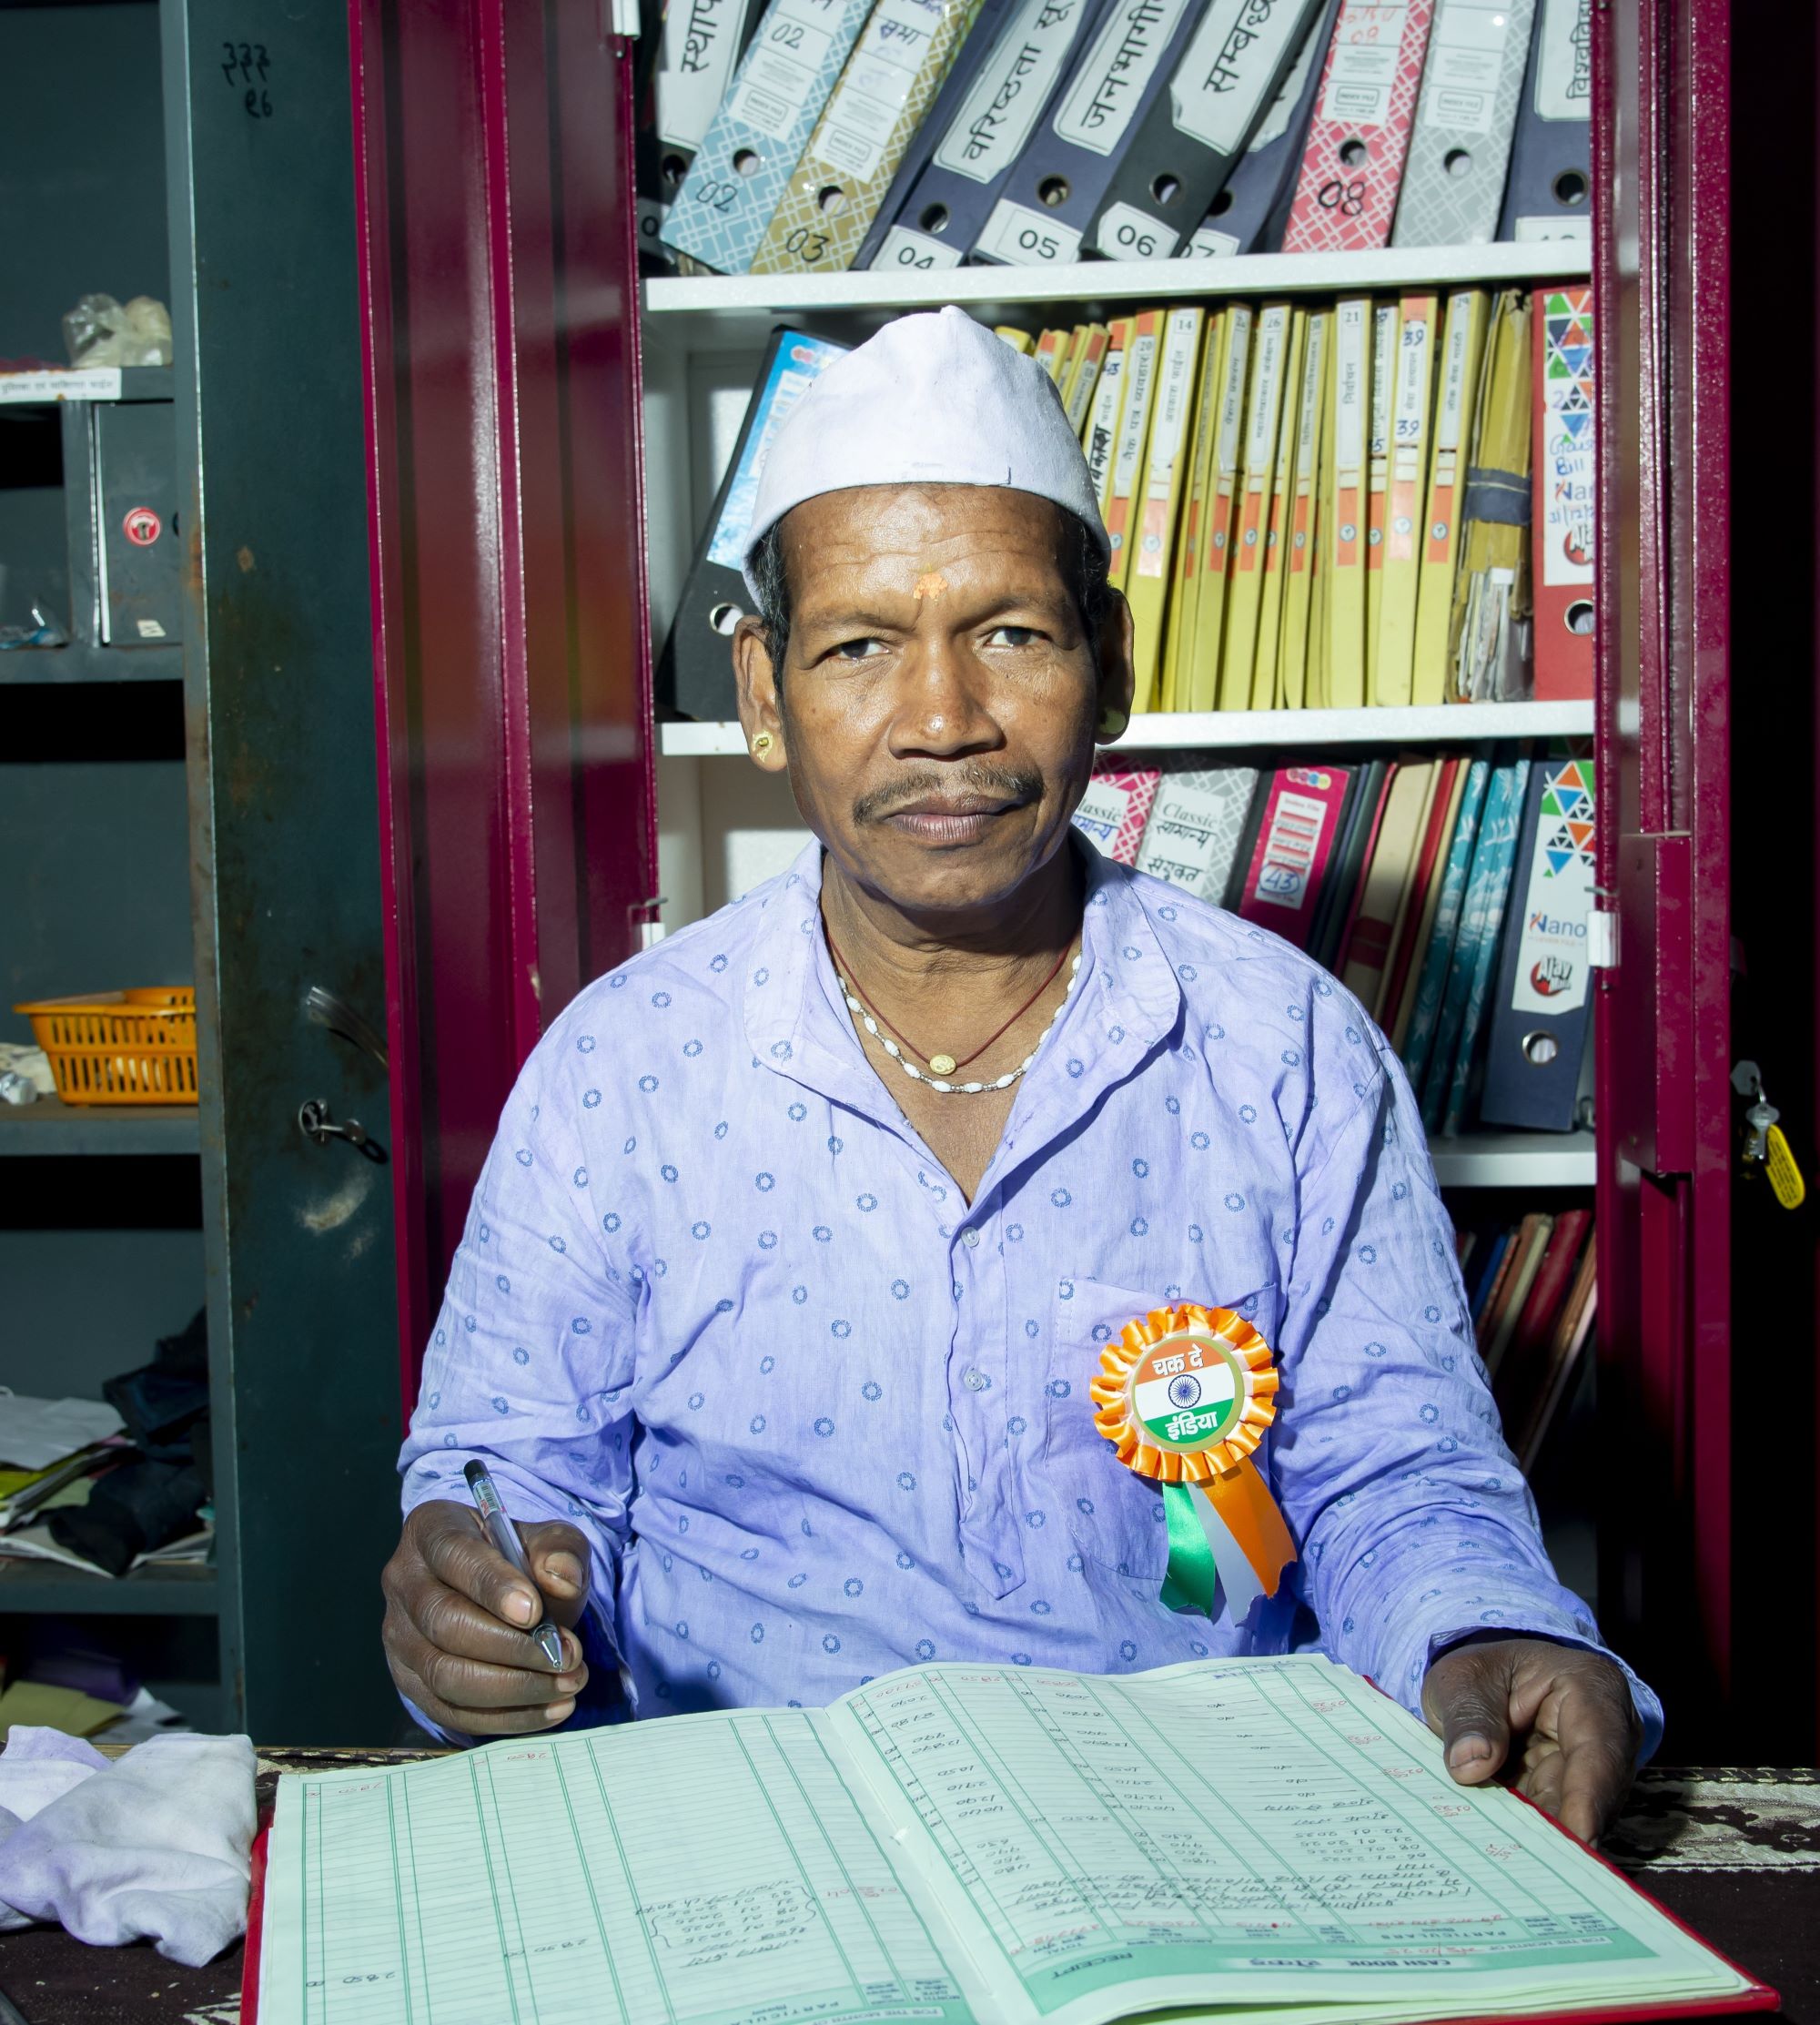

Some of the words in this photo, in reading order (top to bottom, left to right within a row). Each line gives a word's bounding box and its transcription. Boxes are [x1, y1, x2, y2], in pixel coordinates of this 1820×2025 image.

[772, 24, 805, 49] 02
[696, 182, 737, 212] 02
[1318, 181, 1366, 217] 08
[785, 228, 830, 262] 03
[1018, 229, 1061, 259] 05
[1117, 224, 1157, 257] 06
[897, 247, 935, 270] 04
[1178, 319, 1192, 330] 14
[1345, 311, 1359, 322] 21
[1403, 329, 1424, 346] 39
[1342, 363, 1355, 404] निर्वाचन
[1397, 420, 1420, 435] 39
[1078, 799, 1122, 823] lassic
[1162, 802, 1218, 829] Classic
[1264, 868, 1296, 891] 43
[1529, 910, 1587, 938] Nano
[1188, 1342, 1205, 1369] दे
[1165, 1411, 1218, 1442] इंडिया
[946, 1780, 987, 1791] 2910
[956, 1794, 996, 1806] 1290
[1381, 1930, 1507, 1940] PARTICULARS
[1507, 1940, 1552, 1949] MONTH
[1047, 1942, 1083, 1954] TOTAL
[341, 1971, 396, 1984] 2850
[1050, 1952, 1133, 1980] RECEIPT
[832, 2011, 881, 2022] MONTH
